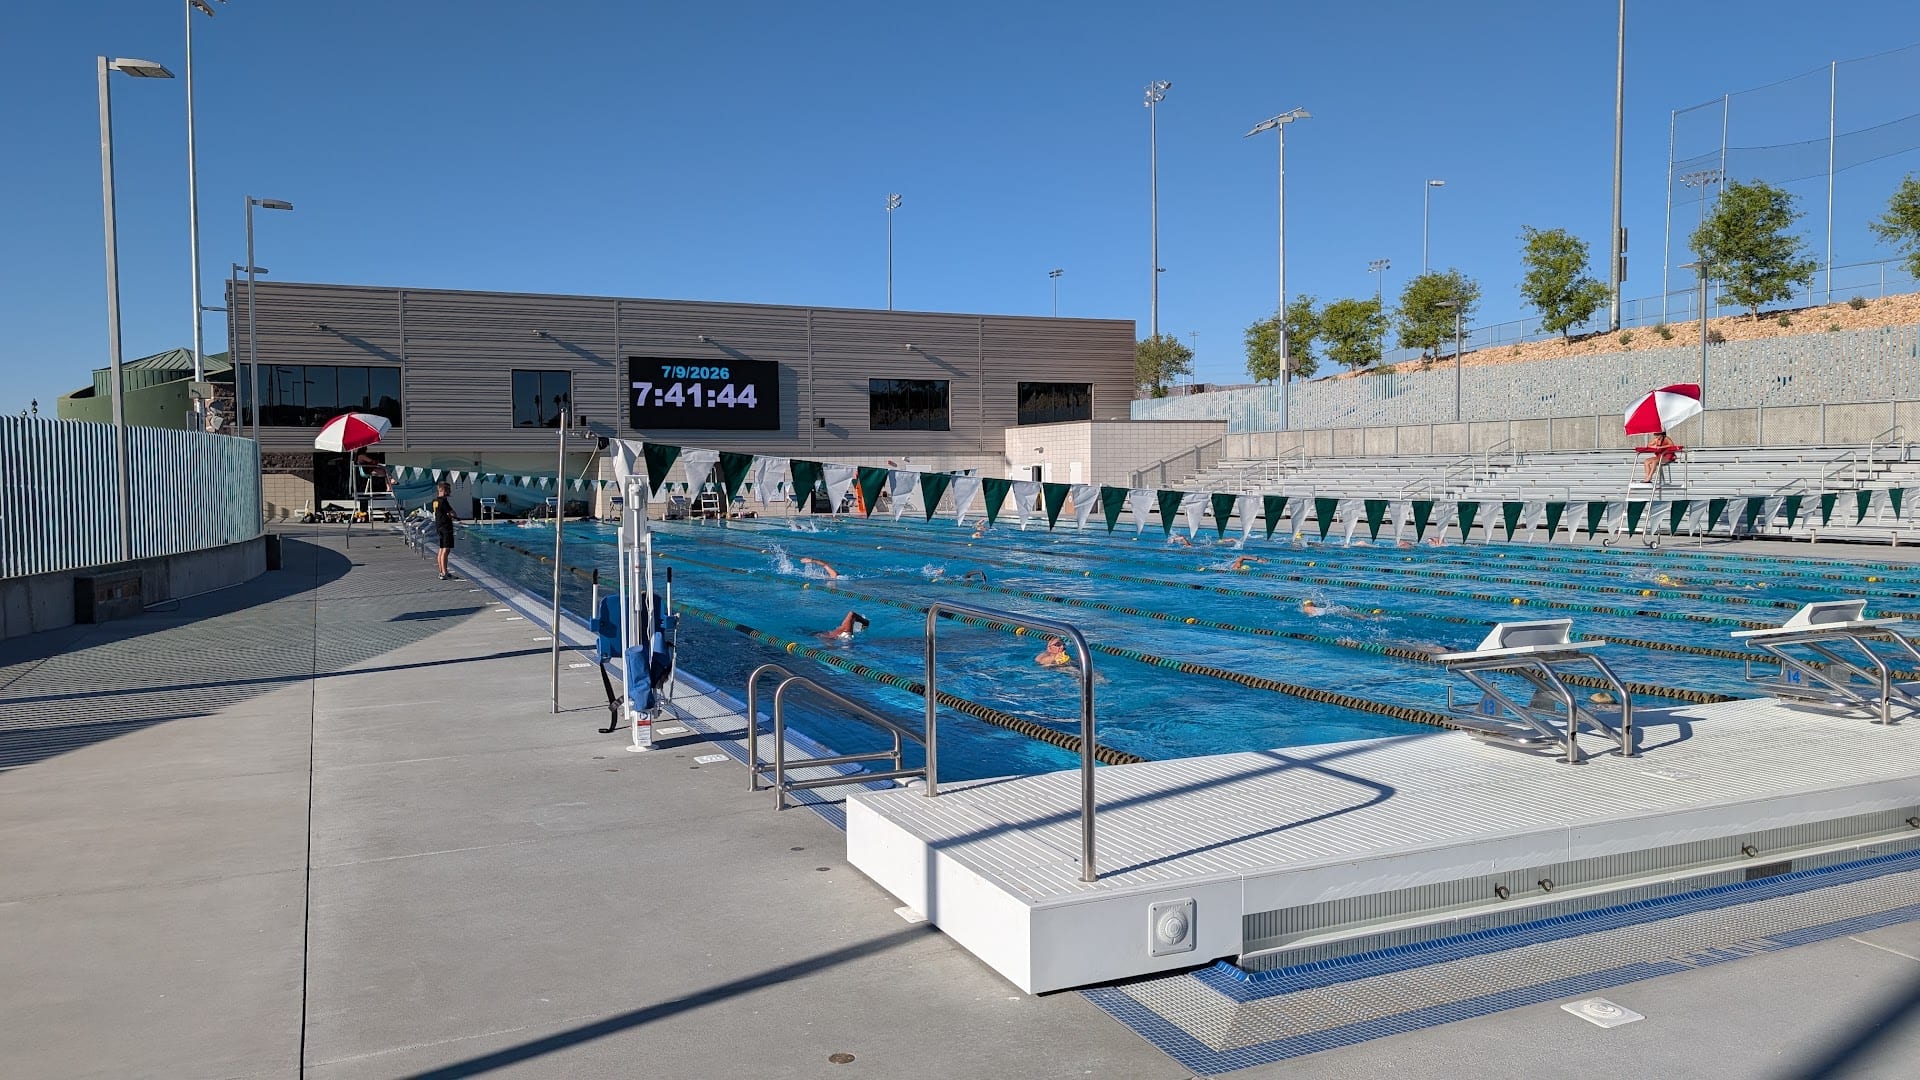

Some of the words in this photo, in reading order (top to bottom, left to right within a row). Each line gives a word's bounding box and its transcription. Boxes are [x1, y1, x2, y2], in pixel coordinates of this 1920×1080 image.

[661, 365, 730, 379] 7/9/2026
[632, 381, 757, 408] 7:41:44
[1787, 669, 1800, 684] 14
